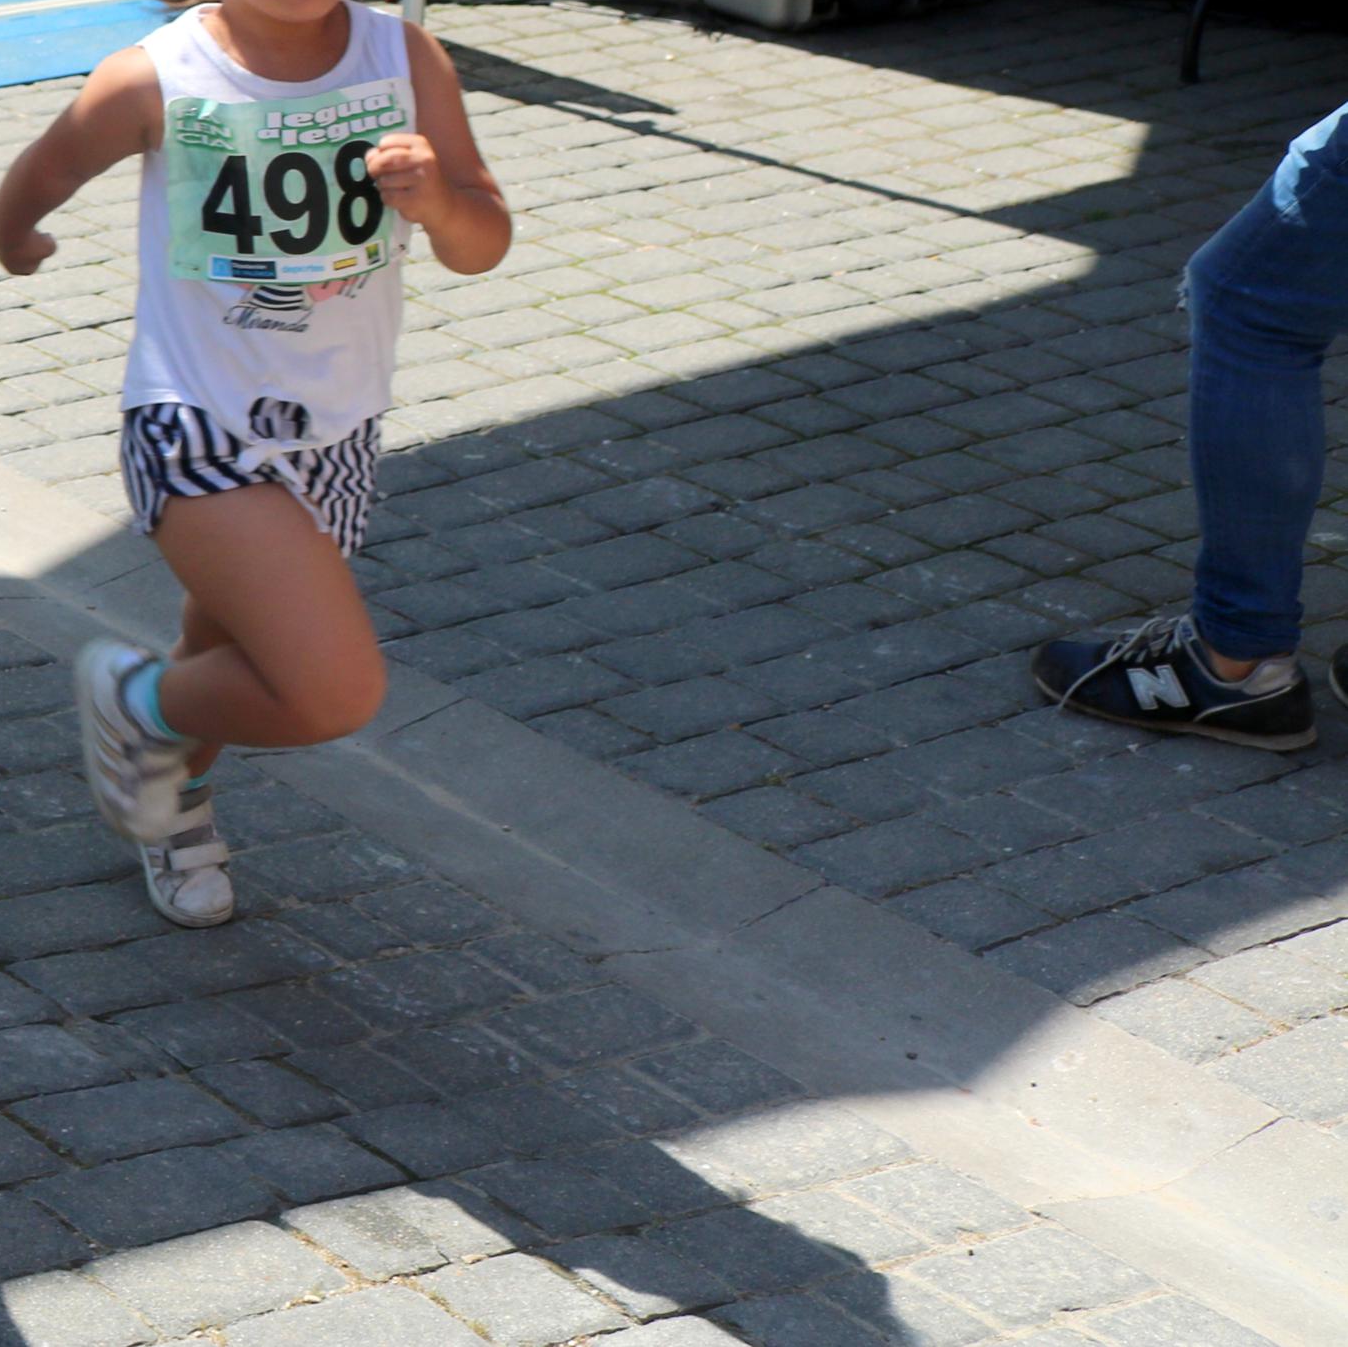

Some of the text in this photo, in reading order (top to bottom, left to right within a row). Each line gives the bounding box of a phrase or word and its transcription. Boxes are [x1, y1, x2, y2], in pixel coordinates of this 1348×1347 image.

[266, 93, 392, 129] legua
[176, 121, 233, 138] LEN
[176, 133, 236, 150] CIA
[201, 139, 385, 255] 498
